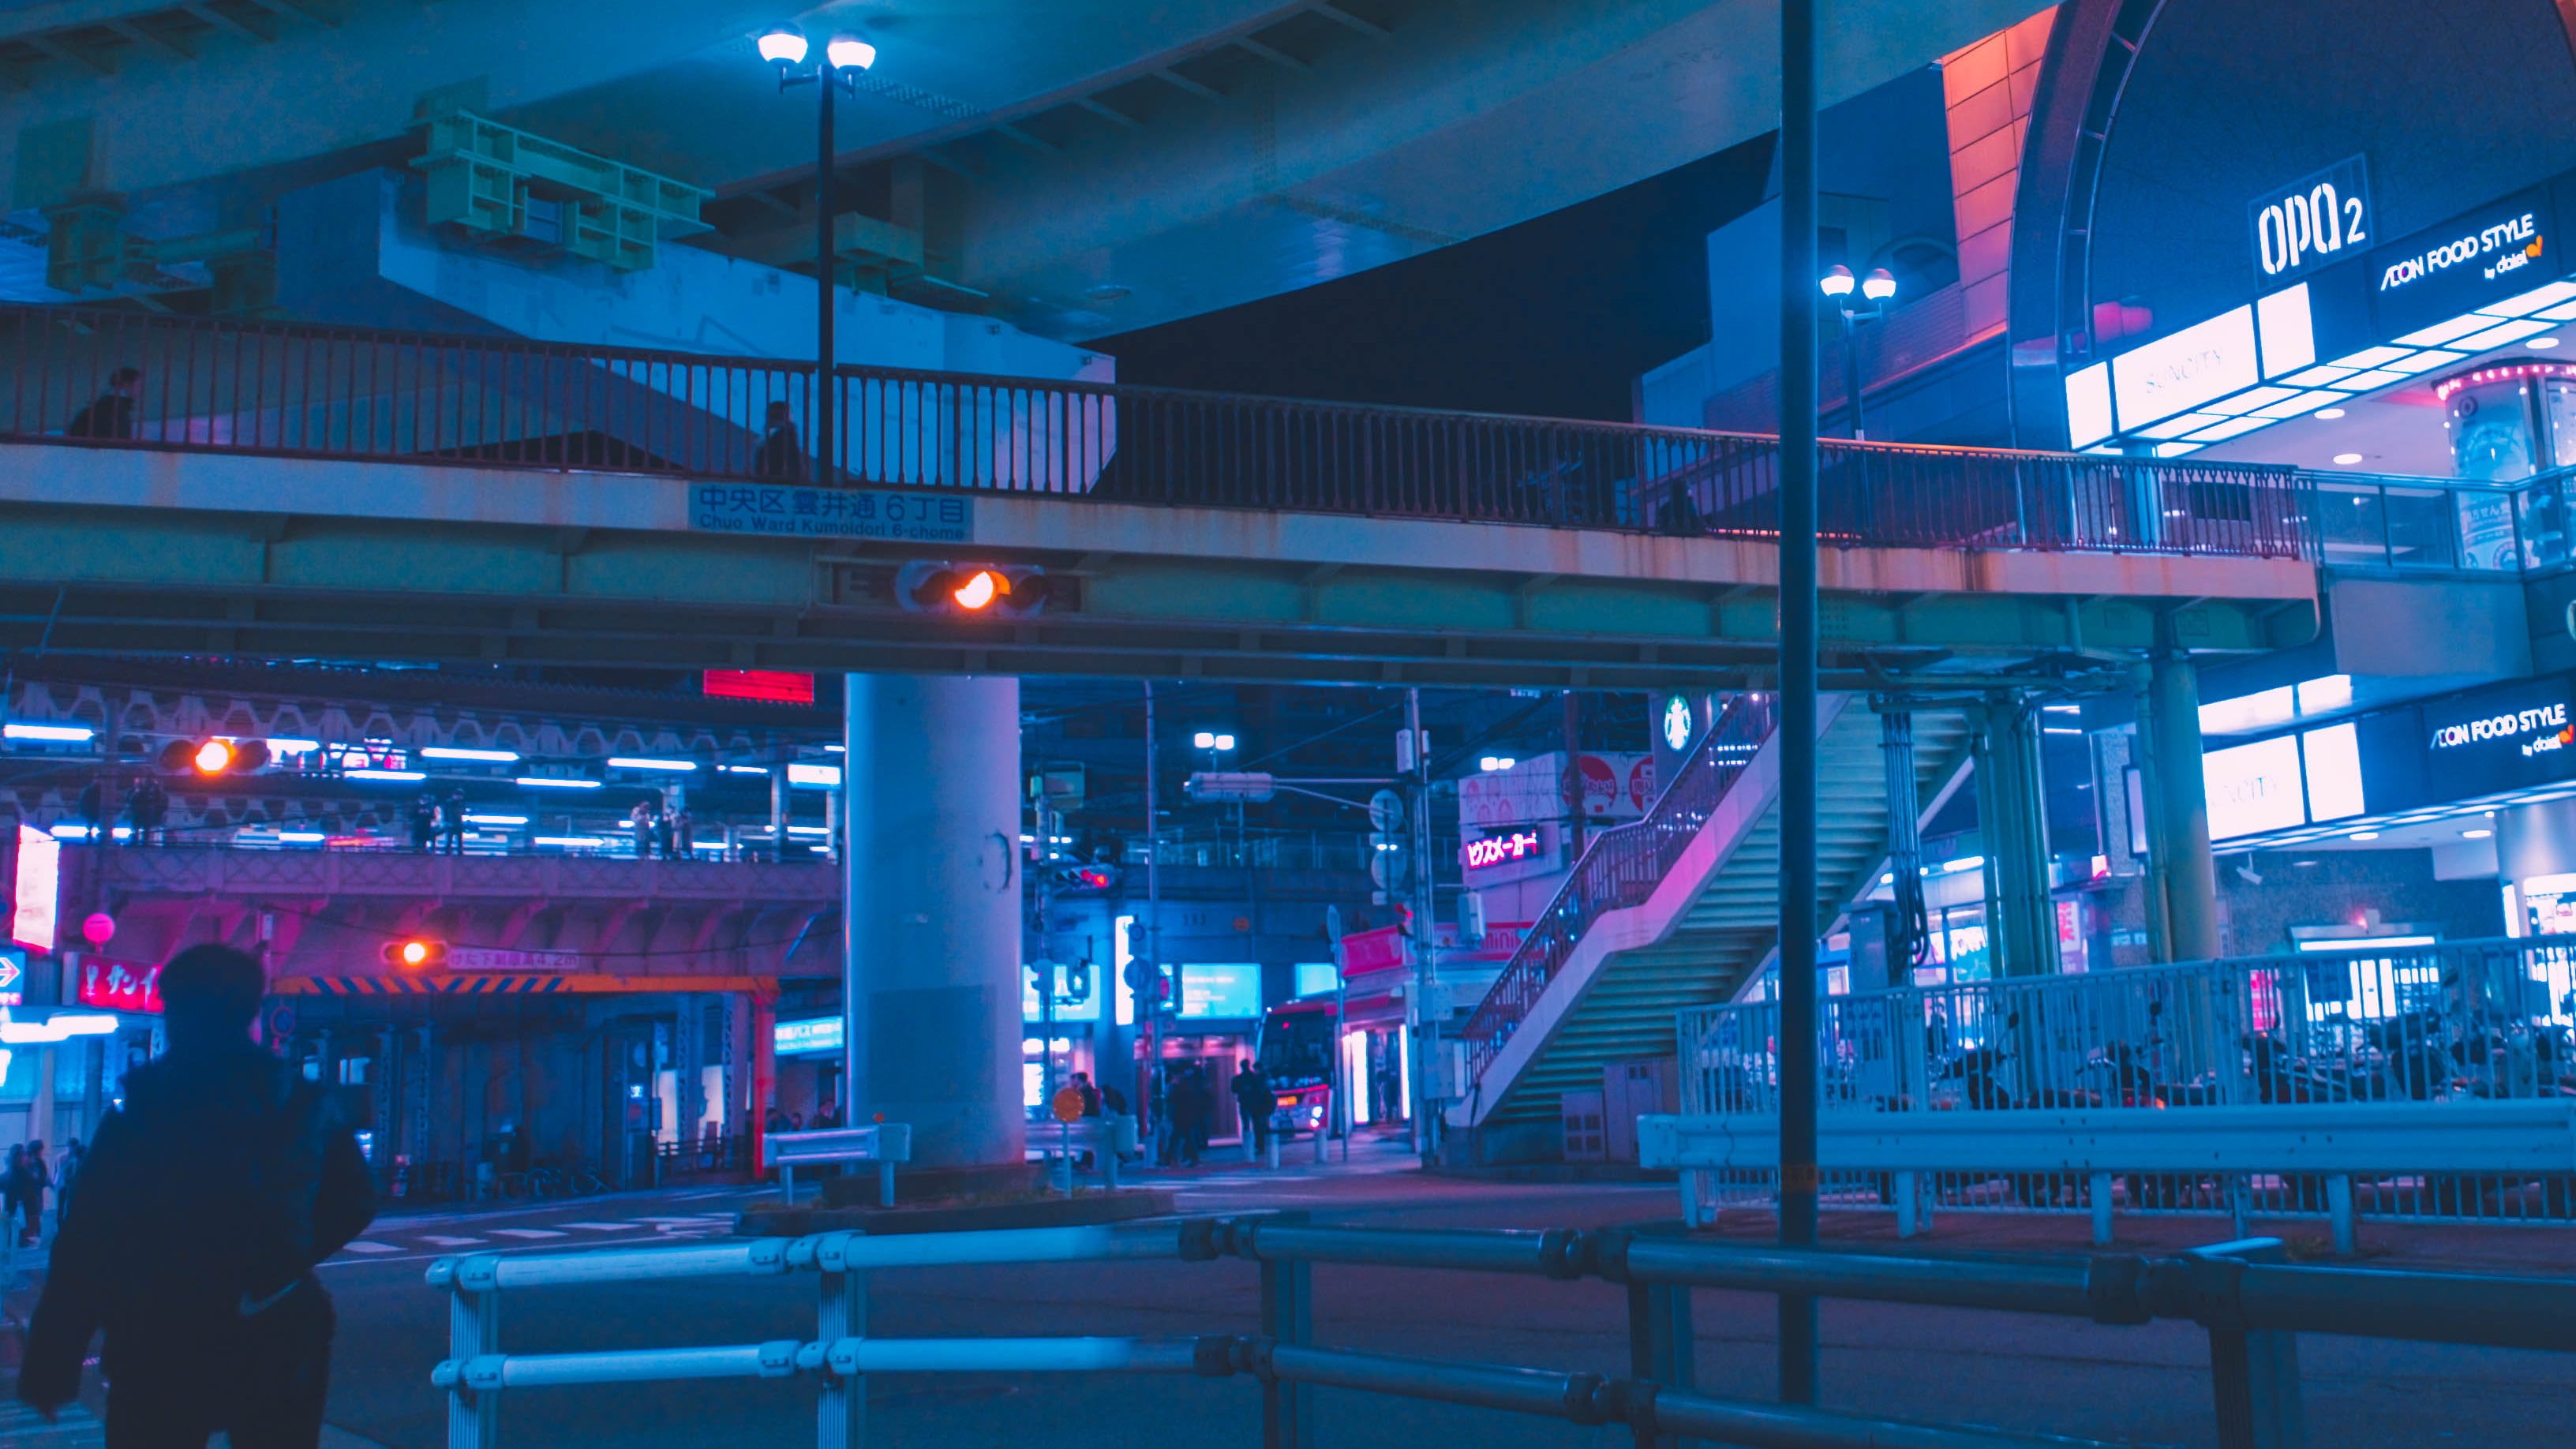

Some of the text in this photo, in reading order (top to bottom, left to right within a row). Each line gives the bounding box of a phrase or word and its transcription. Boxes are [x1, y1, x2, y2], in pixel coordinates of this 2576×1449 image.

[2427, 236, 2479, 273] FOOD
[2481, 213, 2535, 253] STYLE
[699, 513, 964, 541] Chuo Ward Kumoidori 6-chome
[2471, 713, 2518, 742] FOOD
[2519, 703, 2567, 732] STYLE
